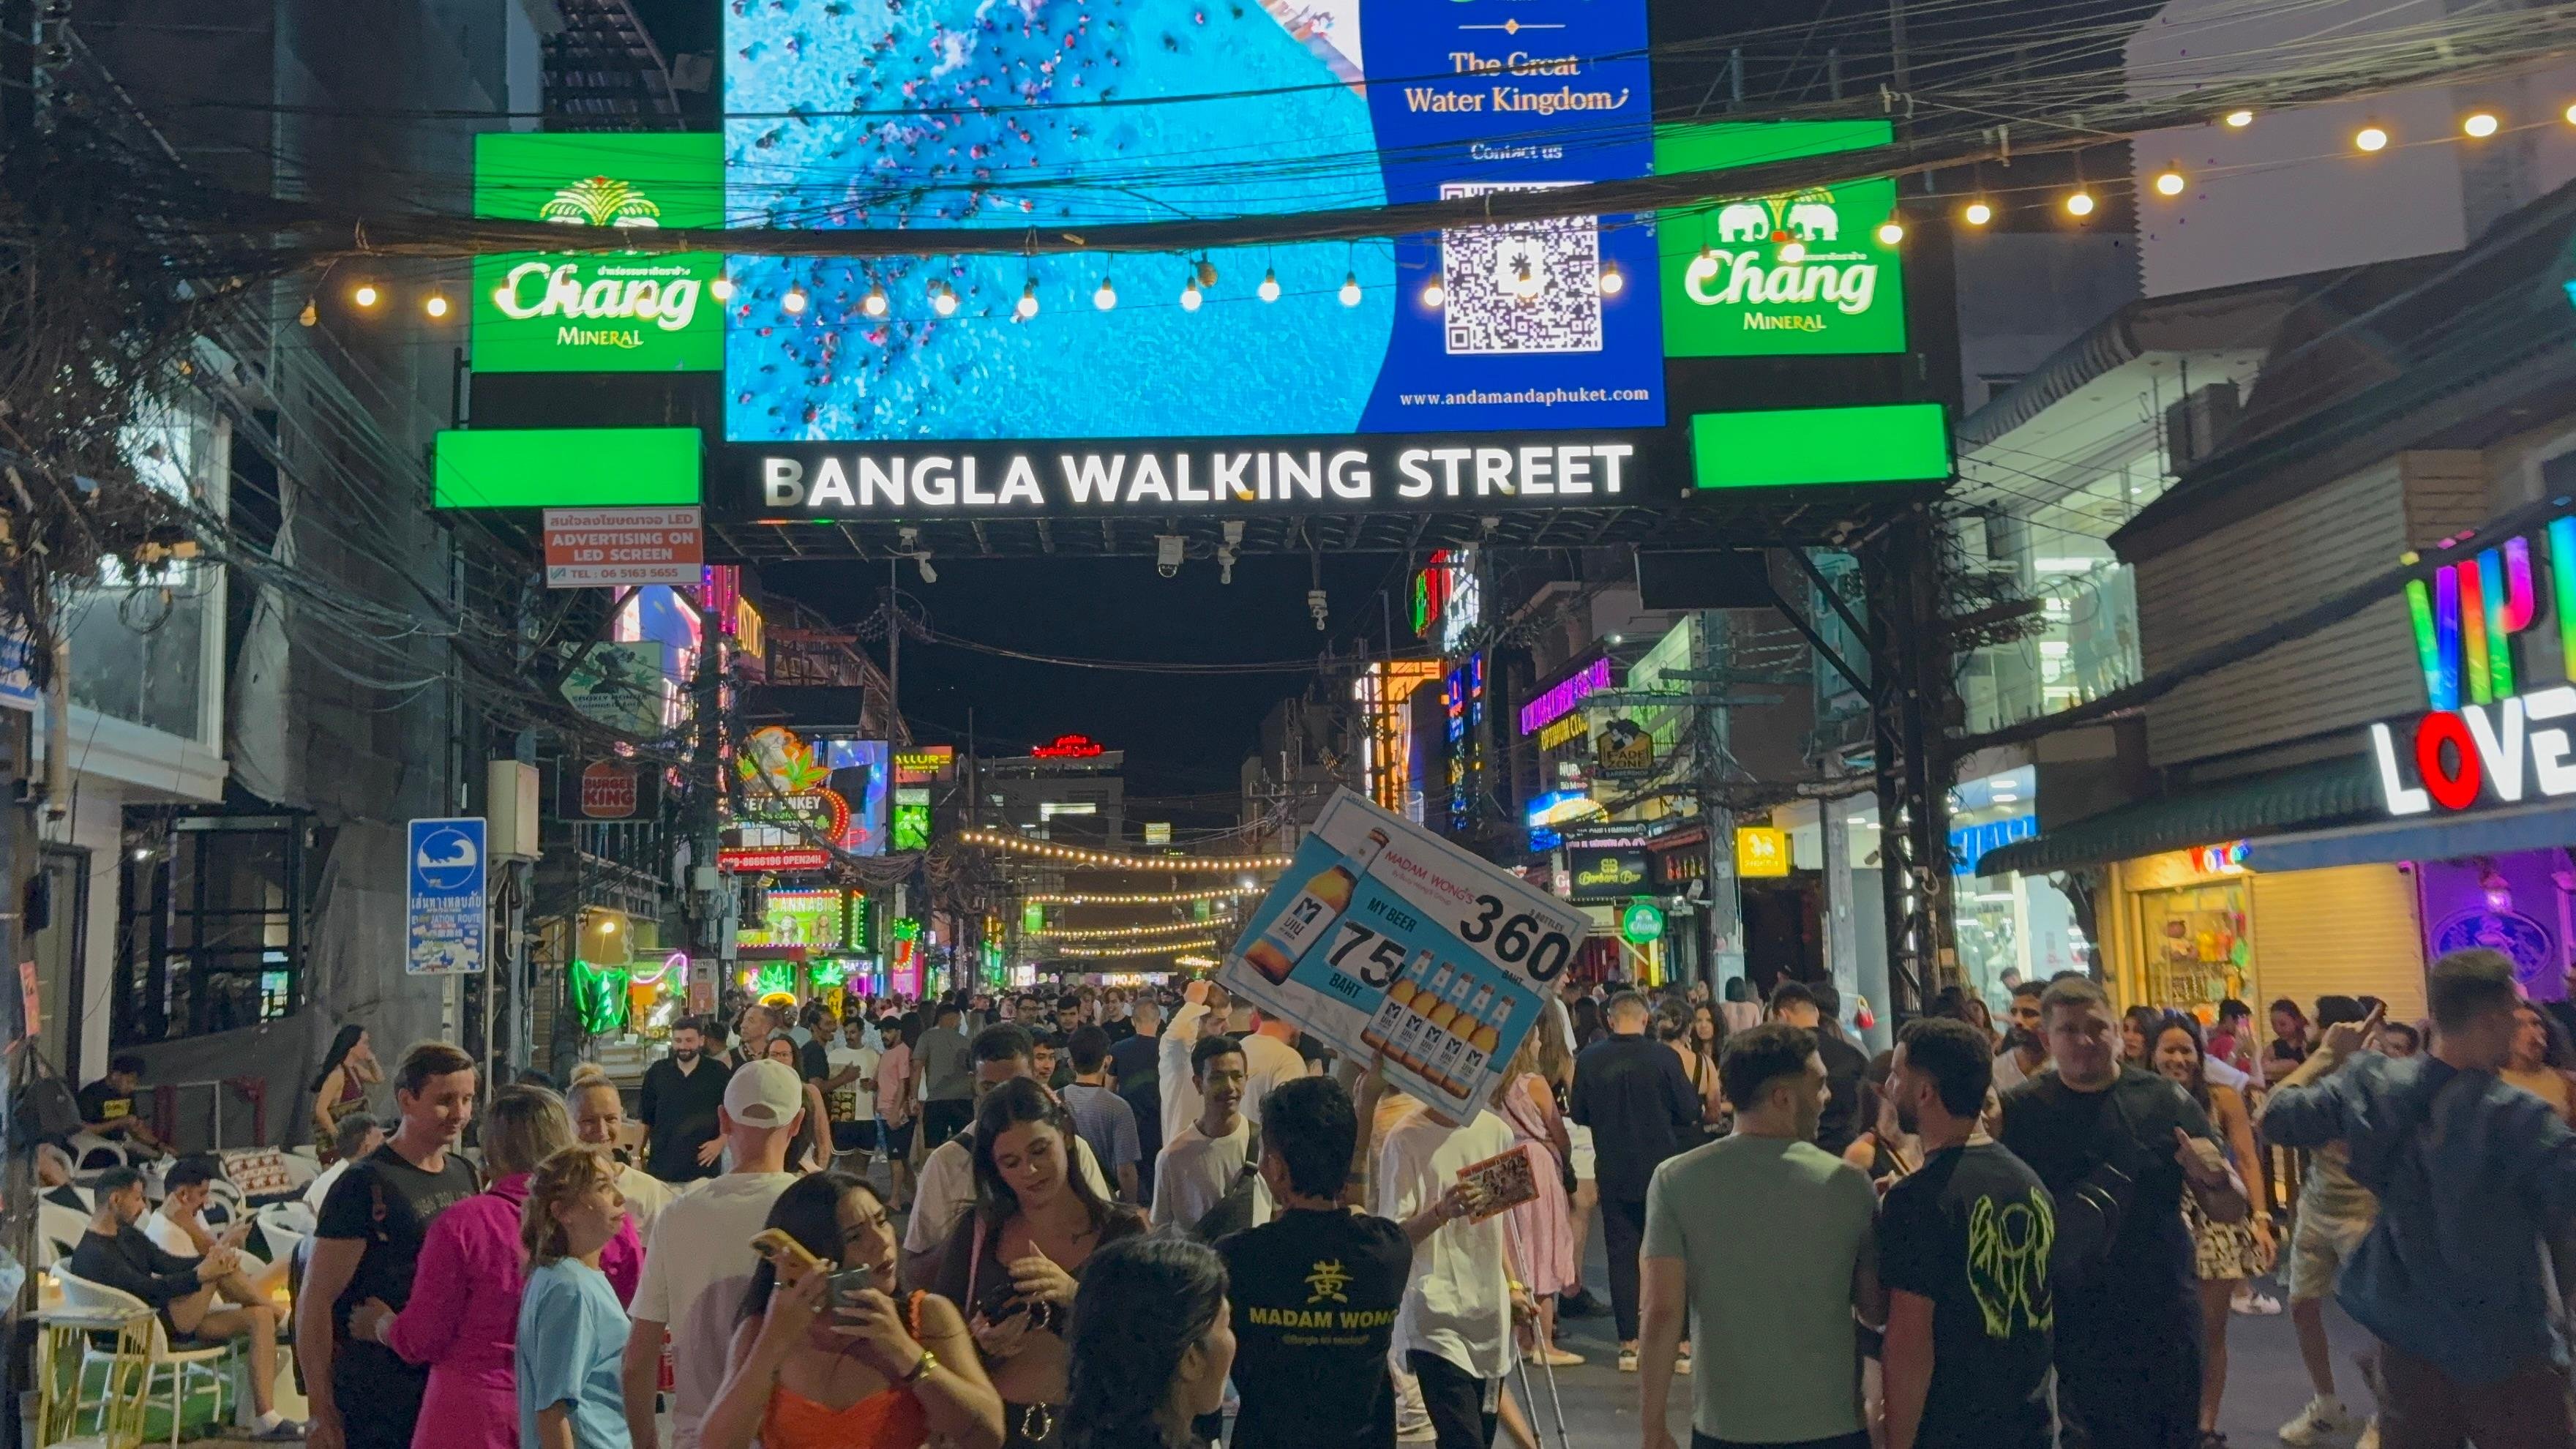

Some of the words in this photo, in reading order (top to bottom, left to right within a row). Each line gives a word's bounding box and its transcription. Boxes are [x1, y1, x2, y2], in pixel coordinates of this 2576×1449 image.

[1449, 52, 1500, 75] The
[1508, 52, 1581, 76] Great
[1404, 87, 1486, 112] Water
[1491, 85, 1630, 115] Kingdom
[1470, 143, 1538, 160] Contact
[1542, 145, 1562, 159] us
[1685, 250, 1878, 315] Chang
[495, 262, 701, 331] Chang
[1399, 387, 1649, 407] www.andamandaphuket.com
[765, 455, 1044, 506] BANGLA
[1061, 450, 1373, 504] WALKING
[1399, 446, 1633, 497] STREET
[668, 514, 694, 525] LED
[552, 533, 663, 546] ADVERTISING
[669, 532, 694, 544] ON
[574, 549, 604, 561] LED
[610, 548, 673, 561] SCREEN
[570, 570, 591, 579] TEL
[601, 569, 616, 578] 06
[621, 569, 646, 578] 5163
[651, 568, 678, 577] 5655
[2371, 686, 2576, 815] LOVE
[583, 790, 634, 806] KING
[1385, 850, 1429, 879] MADAM
[1430, 874, 1476, 905] WONG'S
[771, 896, 836, 913] CANNABIS
[457, 913, 482, 924] ROUTE
[1367, 897, 1389, 914] MY
[1387, 907, 1418, 933] BEER
[1535, 913, 1565, 932] BOTTLES
[1461, 895, 1570, 982] 360
[1330, 921, 1407, 989] 75
[1112, 973, 1141, 986] MOJO
[1329, 972, 1364, 999] BAHT
[1501, 969, 1524, 988] BAHT
[1249, 1307, 1333, 1328] MADAM
